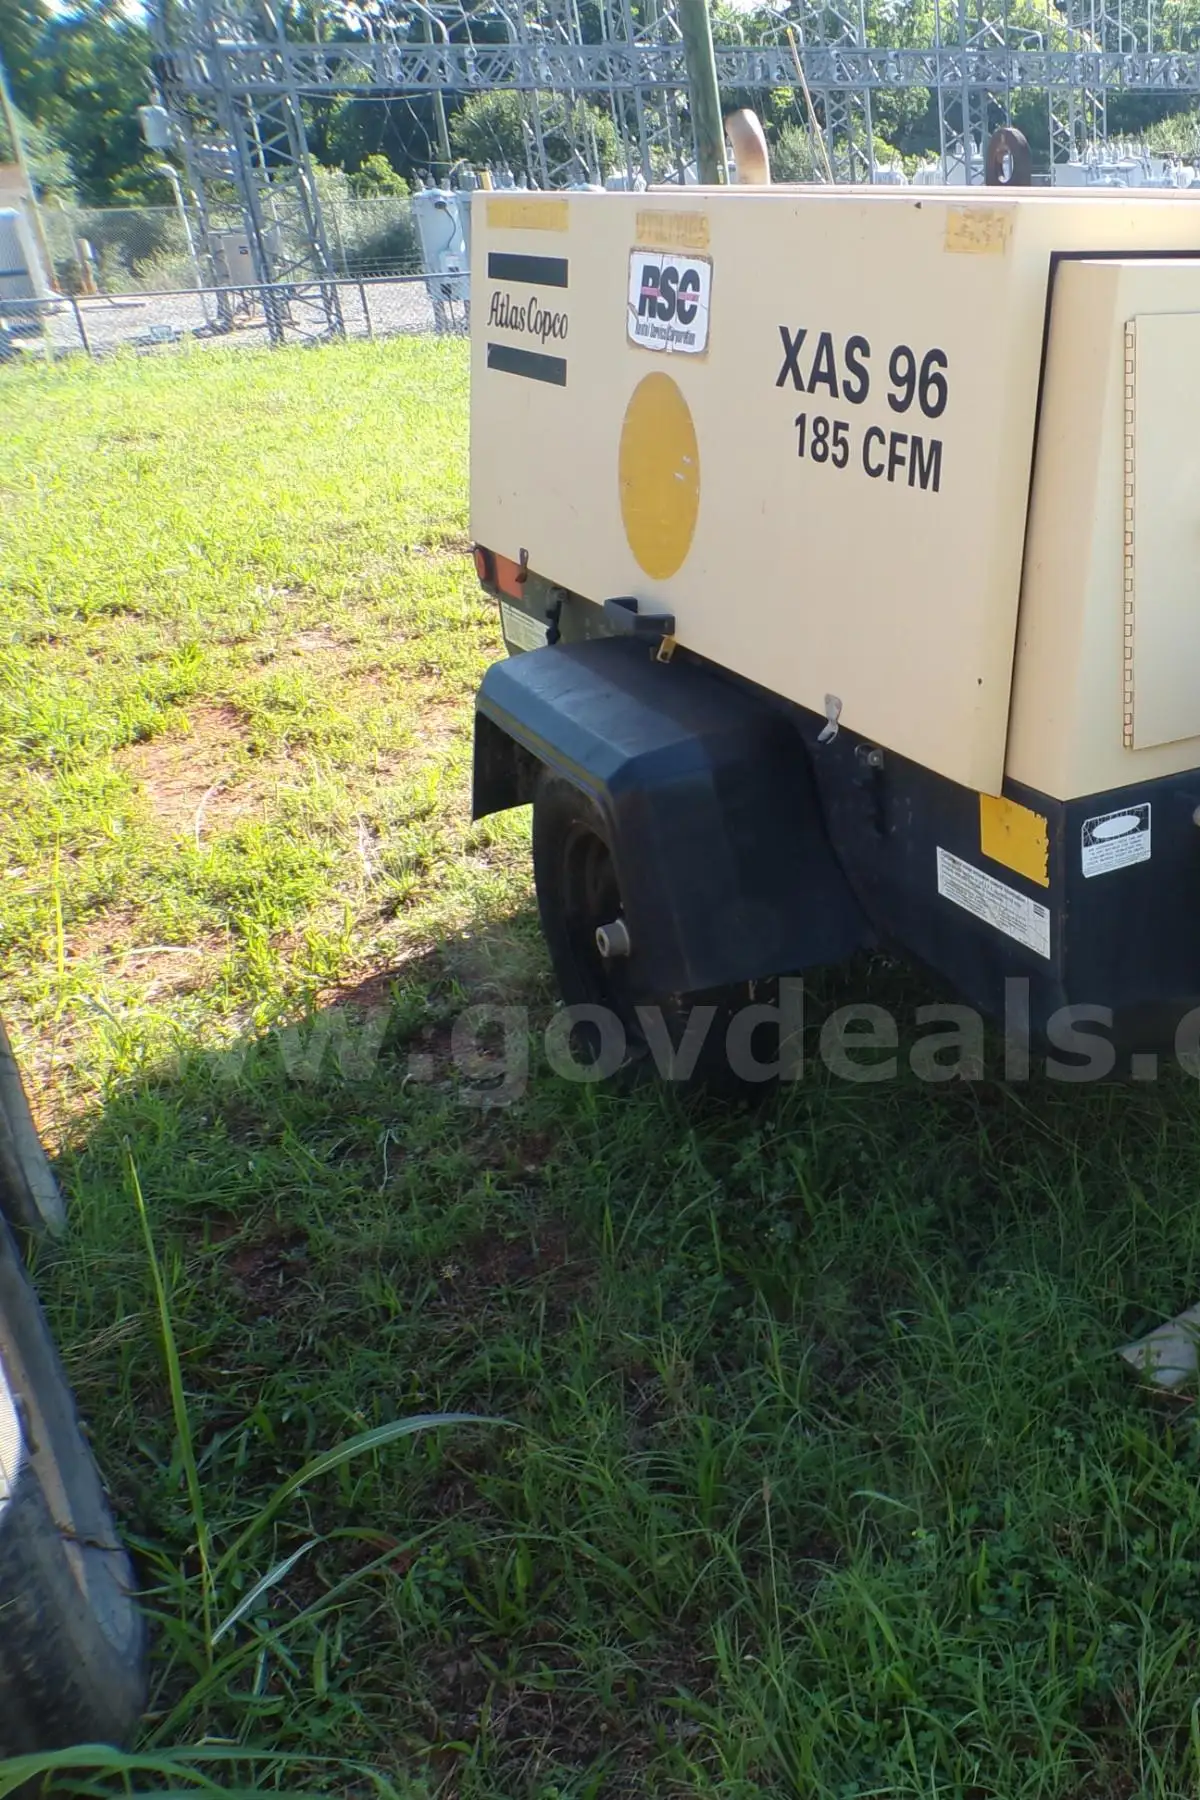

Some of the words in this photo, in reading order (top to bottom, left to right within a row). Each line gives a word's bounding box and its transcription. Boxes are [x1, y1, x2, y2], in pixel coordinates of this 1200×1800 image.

[486, 290, 527, 332] Atlas
[527, 295, 569, 345] Copco
[637, 264, 701, 325] RSC
[775, 325, 871, 405] XAS
[887, 344, 949, 419] 96
[795, 412, 850, 469] 185
[862, 425, 943, 493] CFM
